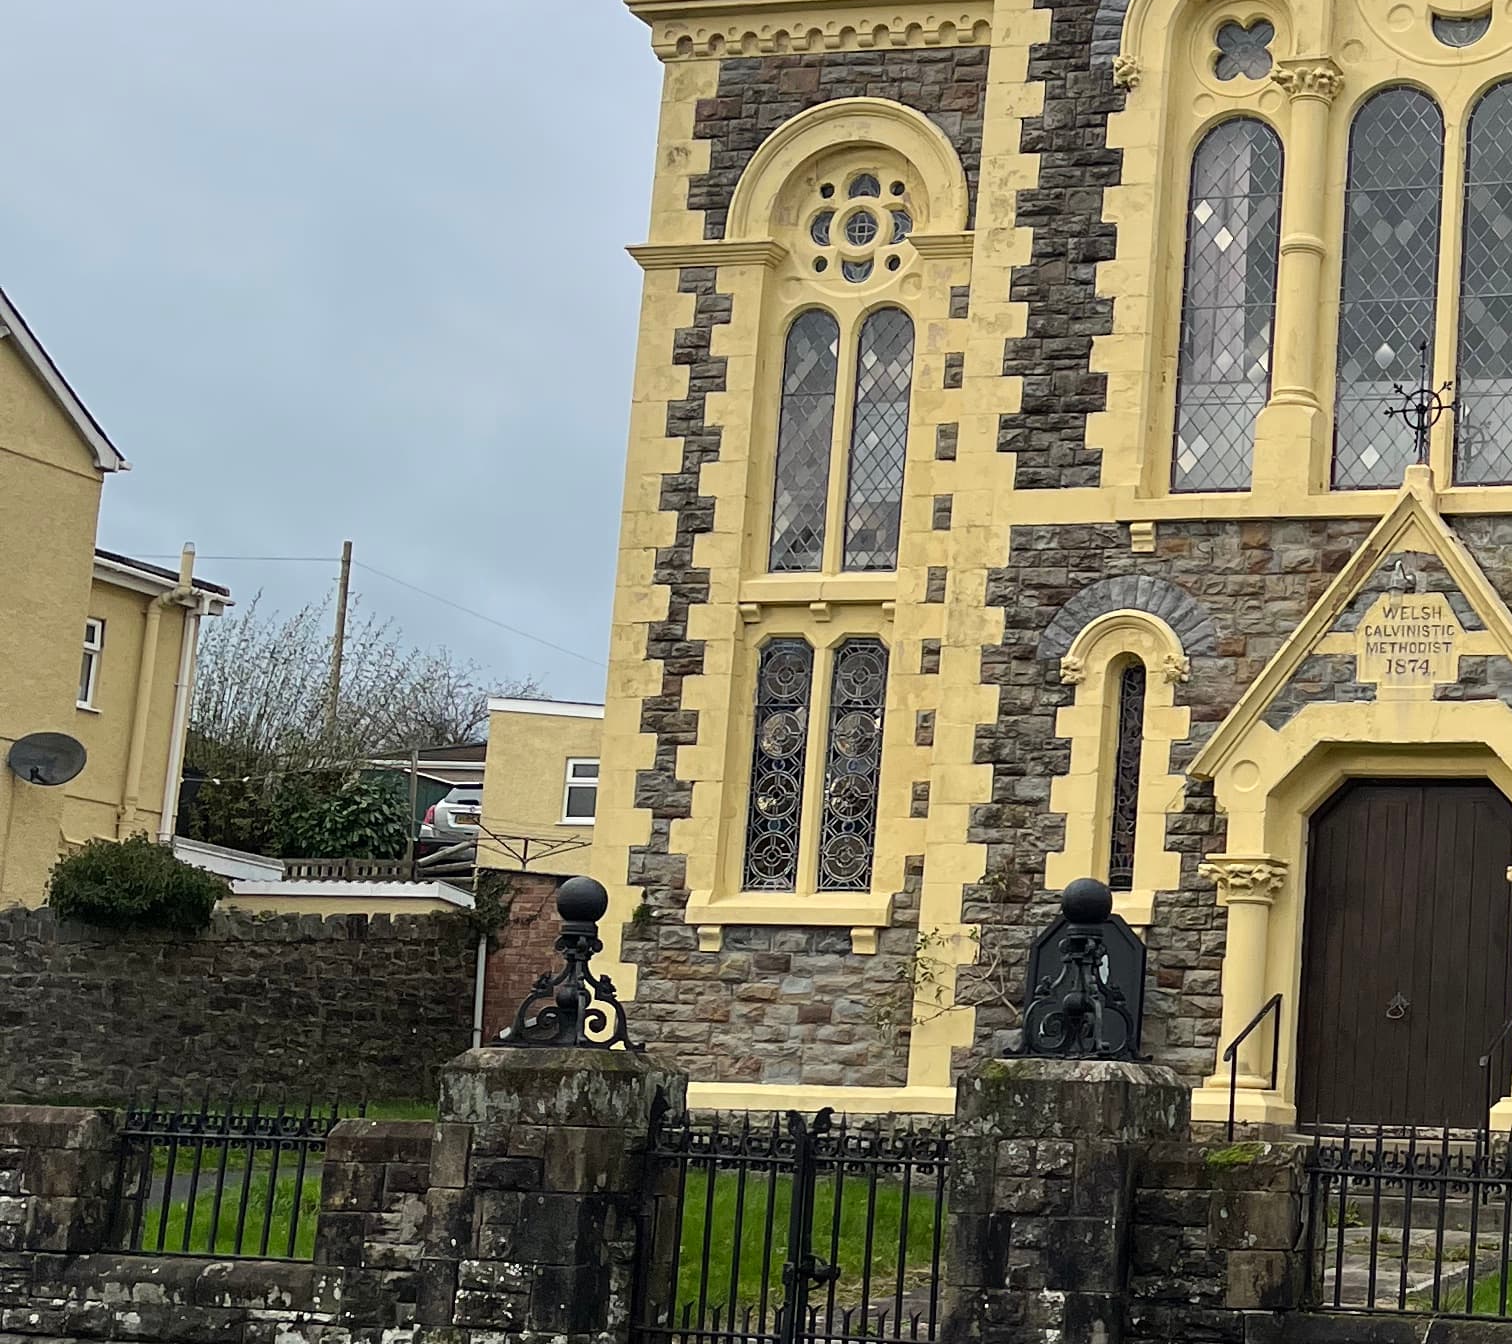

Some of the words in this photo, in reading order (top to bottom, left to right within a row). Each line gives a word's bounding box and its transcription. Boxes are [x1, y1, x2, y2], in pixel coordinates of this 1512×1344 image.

[1382, 605, 1442, 621] WELSH
[1364, 624, 1455, 637] CALVINISTIC
[1366, 641, 1452, 654] METHODIST
